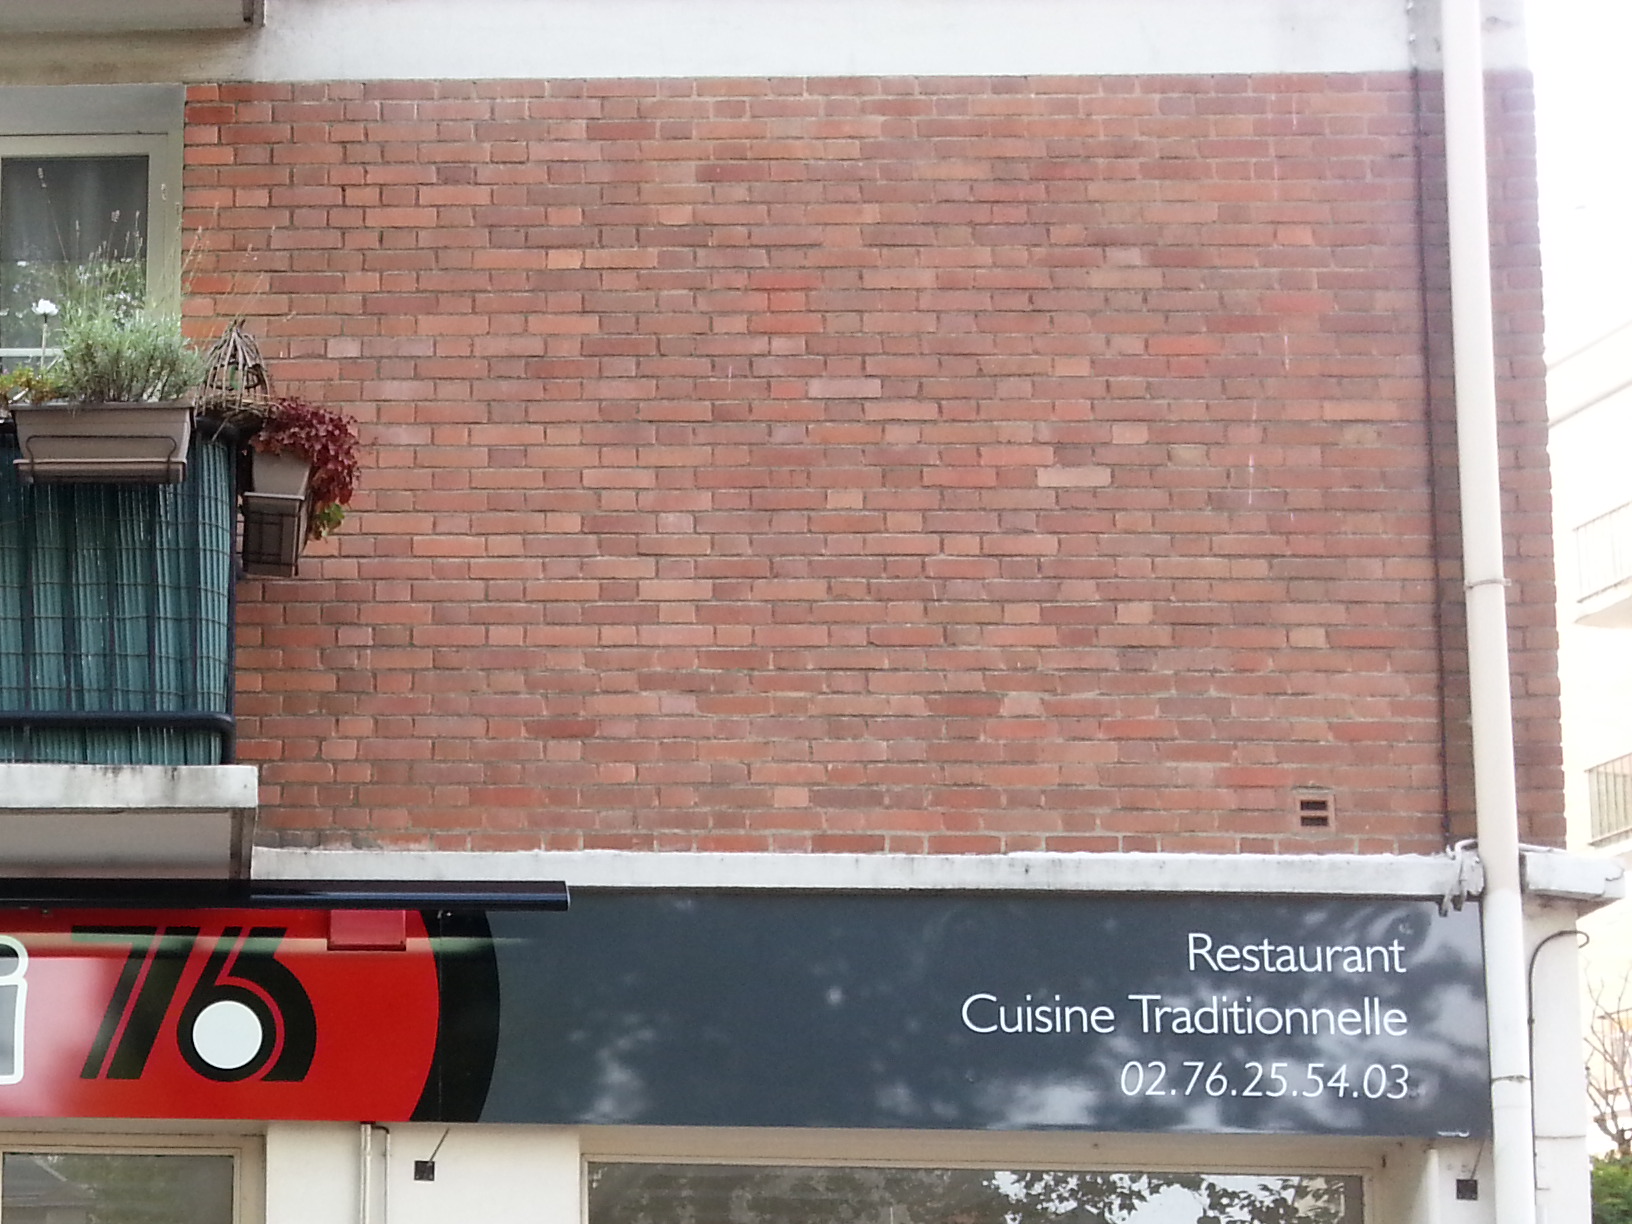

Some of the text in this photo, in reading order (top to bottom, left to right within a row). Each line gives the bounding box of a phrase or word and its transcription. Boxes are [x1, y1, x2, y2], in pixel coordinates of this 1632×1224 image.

[1188, 933, 1406, 974] Restaurant
[70, 925, 317, 1082] 76
[962, 993, 1408, 1036] Cuisine Traditionnelle
[1120, 1061, 1409, 1099] 02.76.25.54.03
